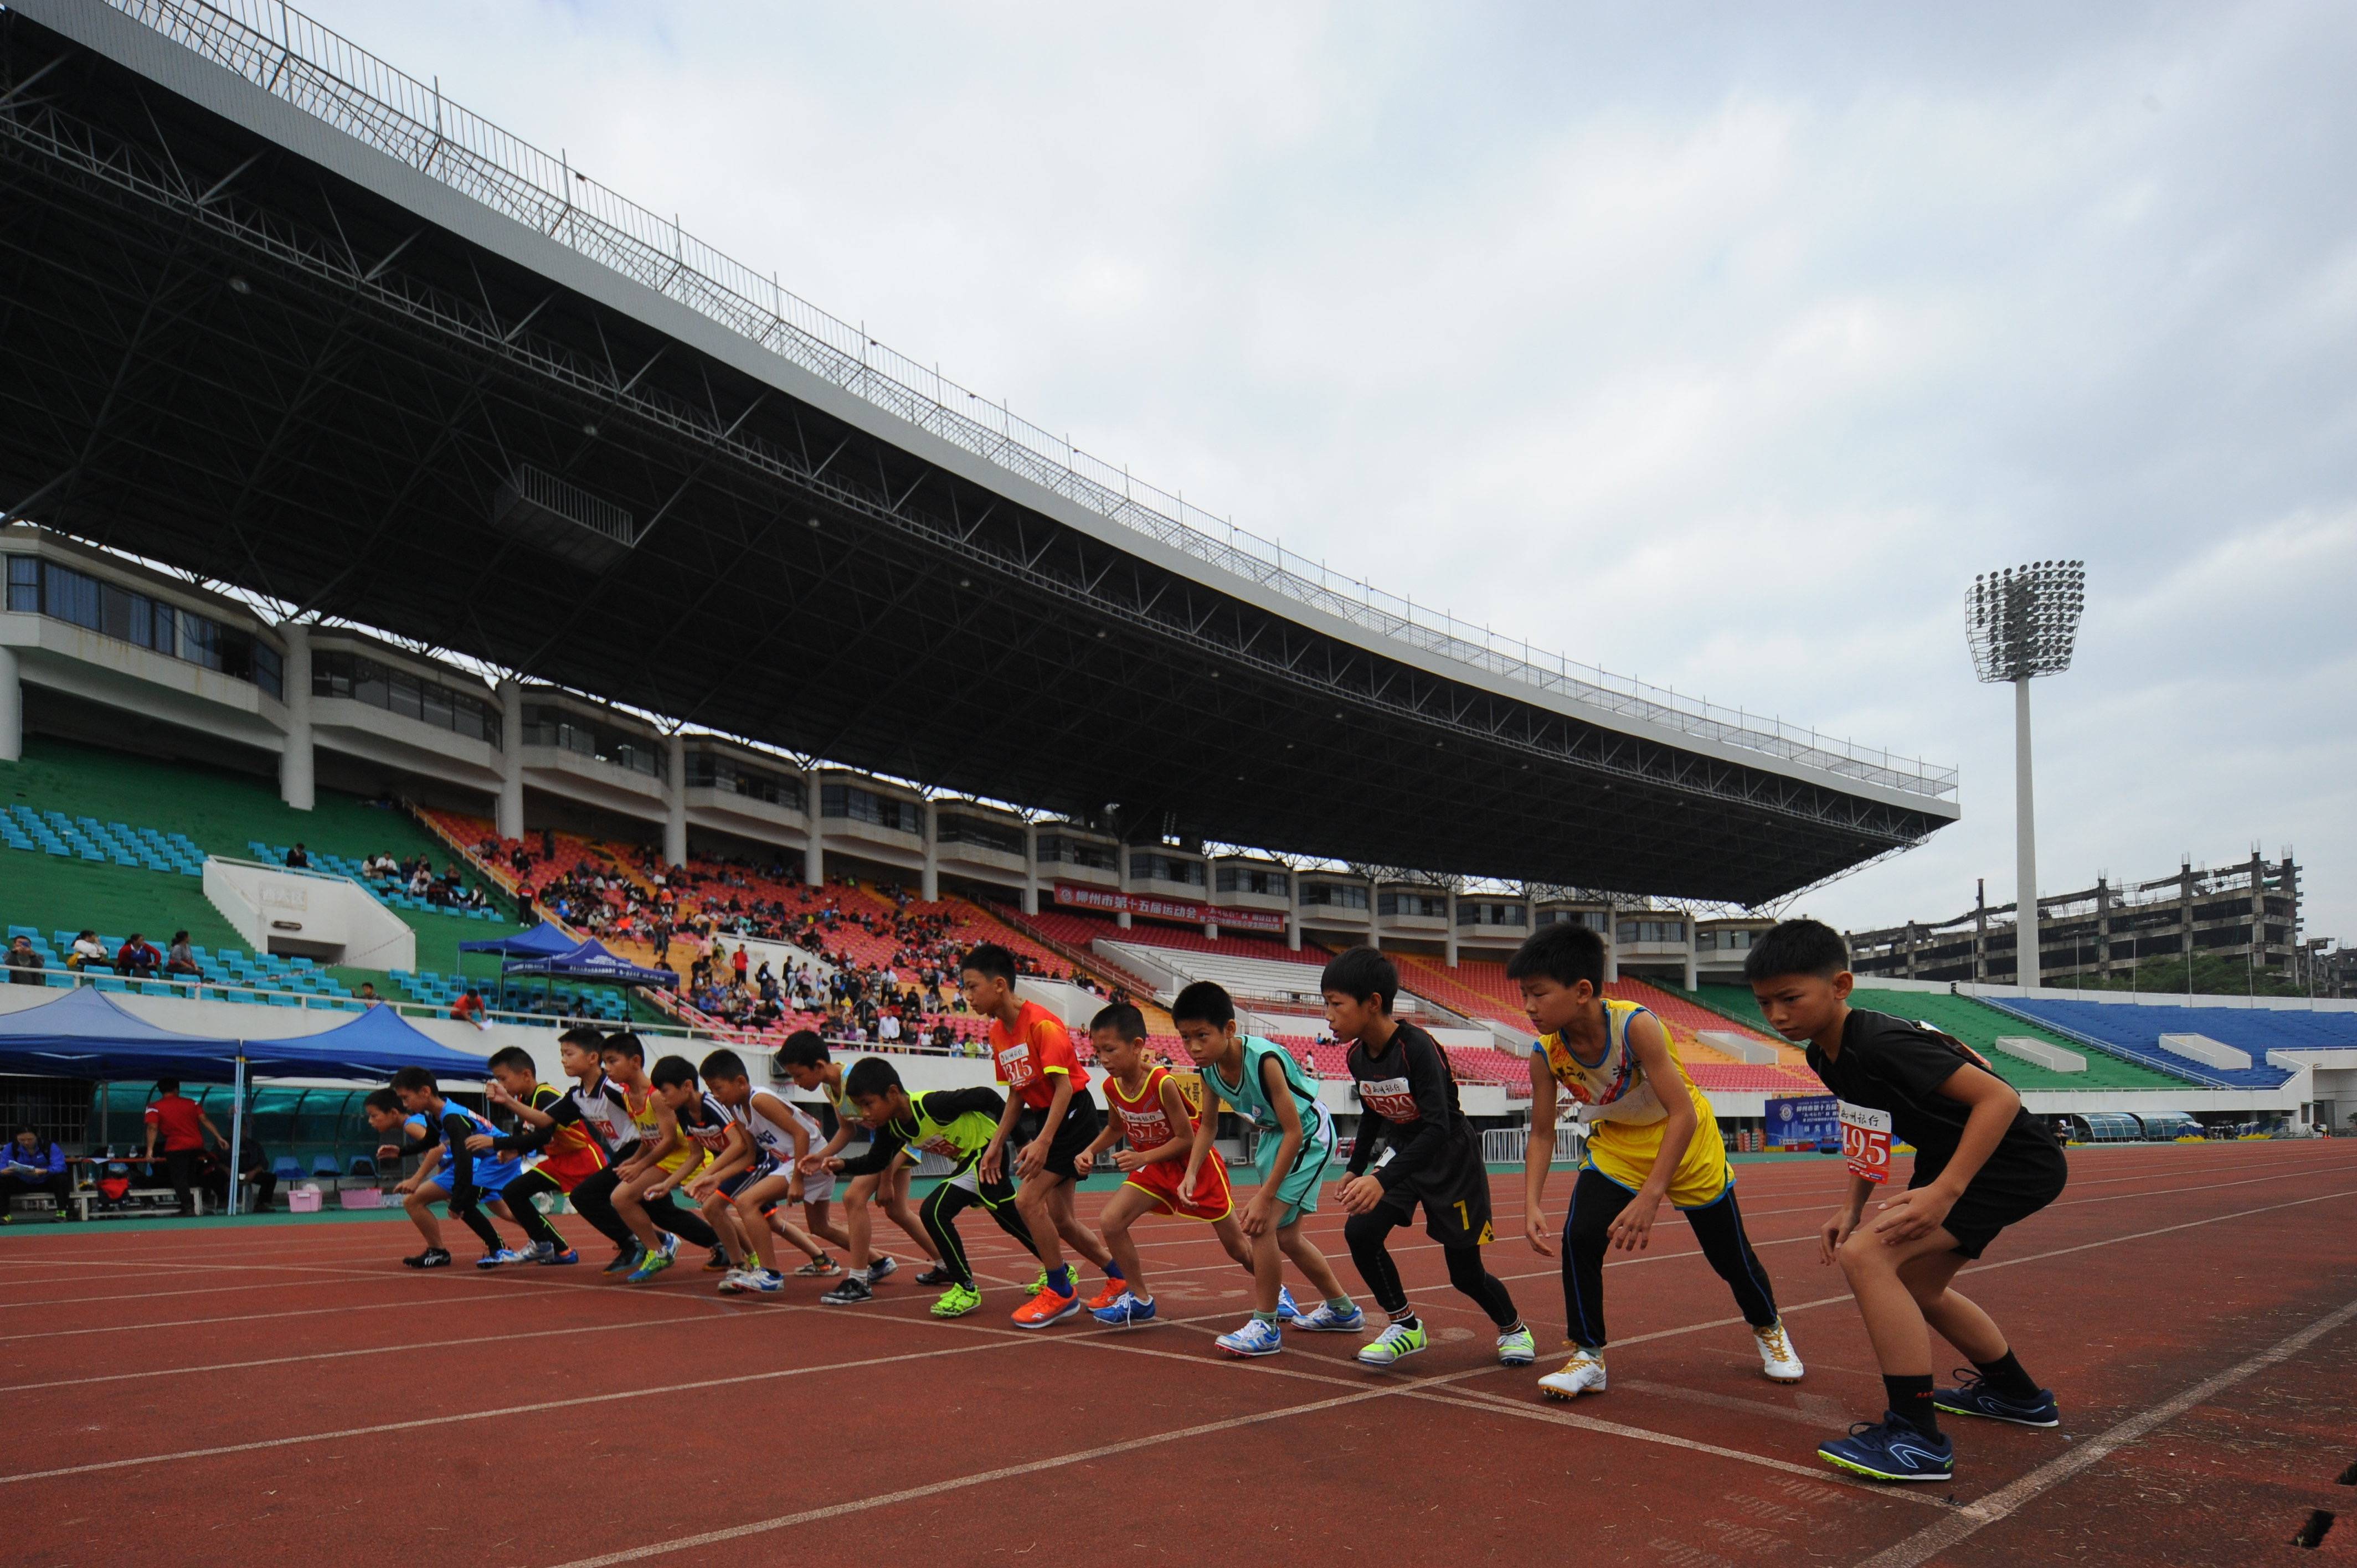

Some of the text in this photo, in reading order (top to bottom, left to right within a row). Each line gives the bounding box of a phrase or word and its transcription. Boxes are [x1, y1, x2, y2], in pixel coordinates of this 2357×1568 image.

[1076, 890, 1197, 919] 柳州市第十五届运动会
[1366, 1095, 1417, 1115] 2529
[1841, 1109, 1879, 1126] 柳州银行
